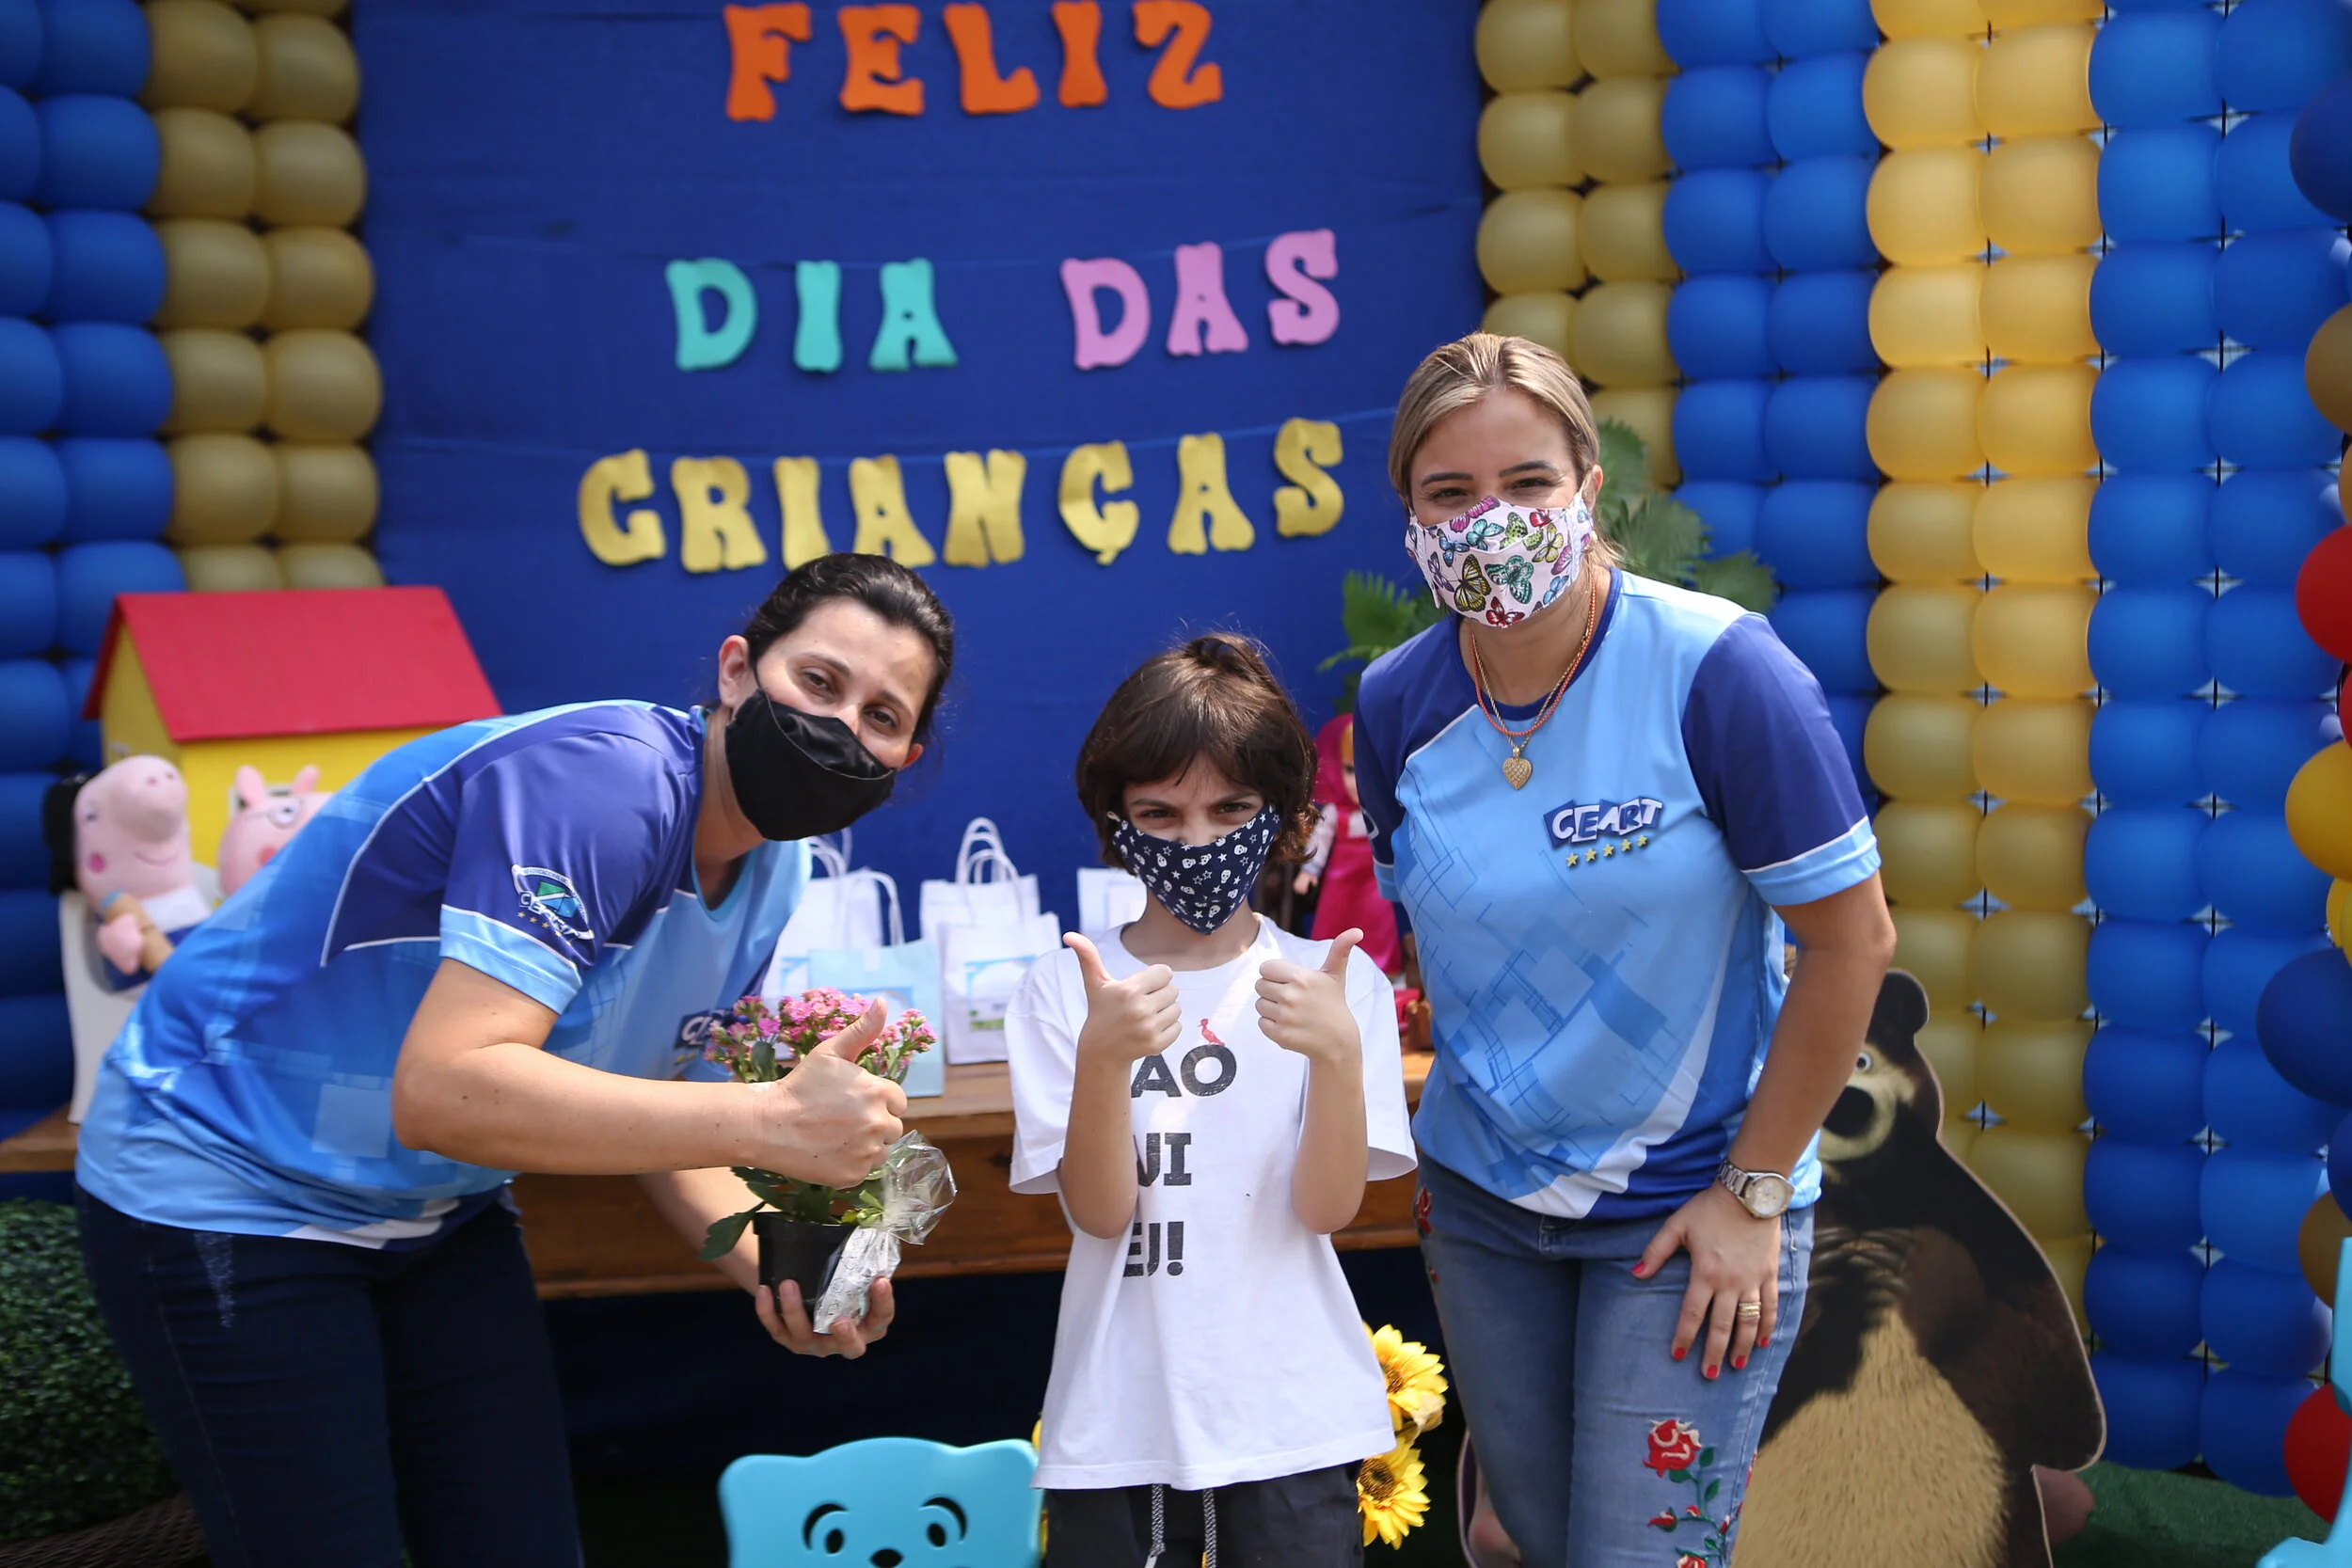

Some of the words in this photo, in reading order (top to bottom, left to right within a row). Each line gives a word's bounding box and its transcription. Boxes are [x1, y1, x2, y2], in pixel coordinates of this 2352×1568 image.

[724, 0, 1222, 120] FELIZ
[667, 259, 958, 372] DIA
[1061, 229, 1340, 371] DAS
[579, 420, 1343, 572] CRIANÇAS
[1552, 799, 1662, 840] CEART
[1131, 1044, 1237, 1099] AO
